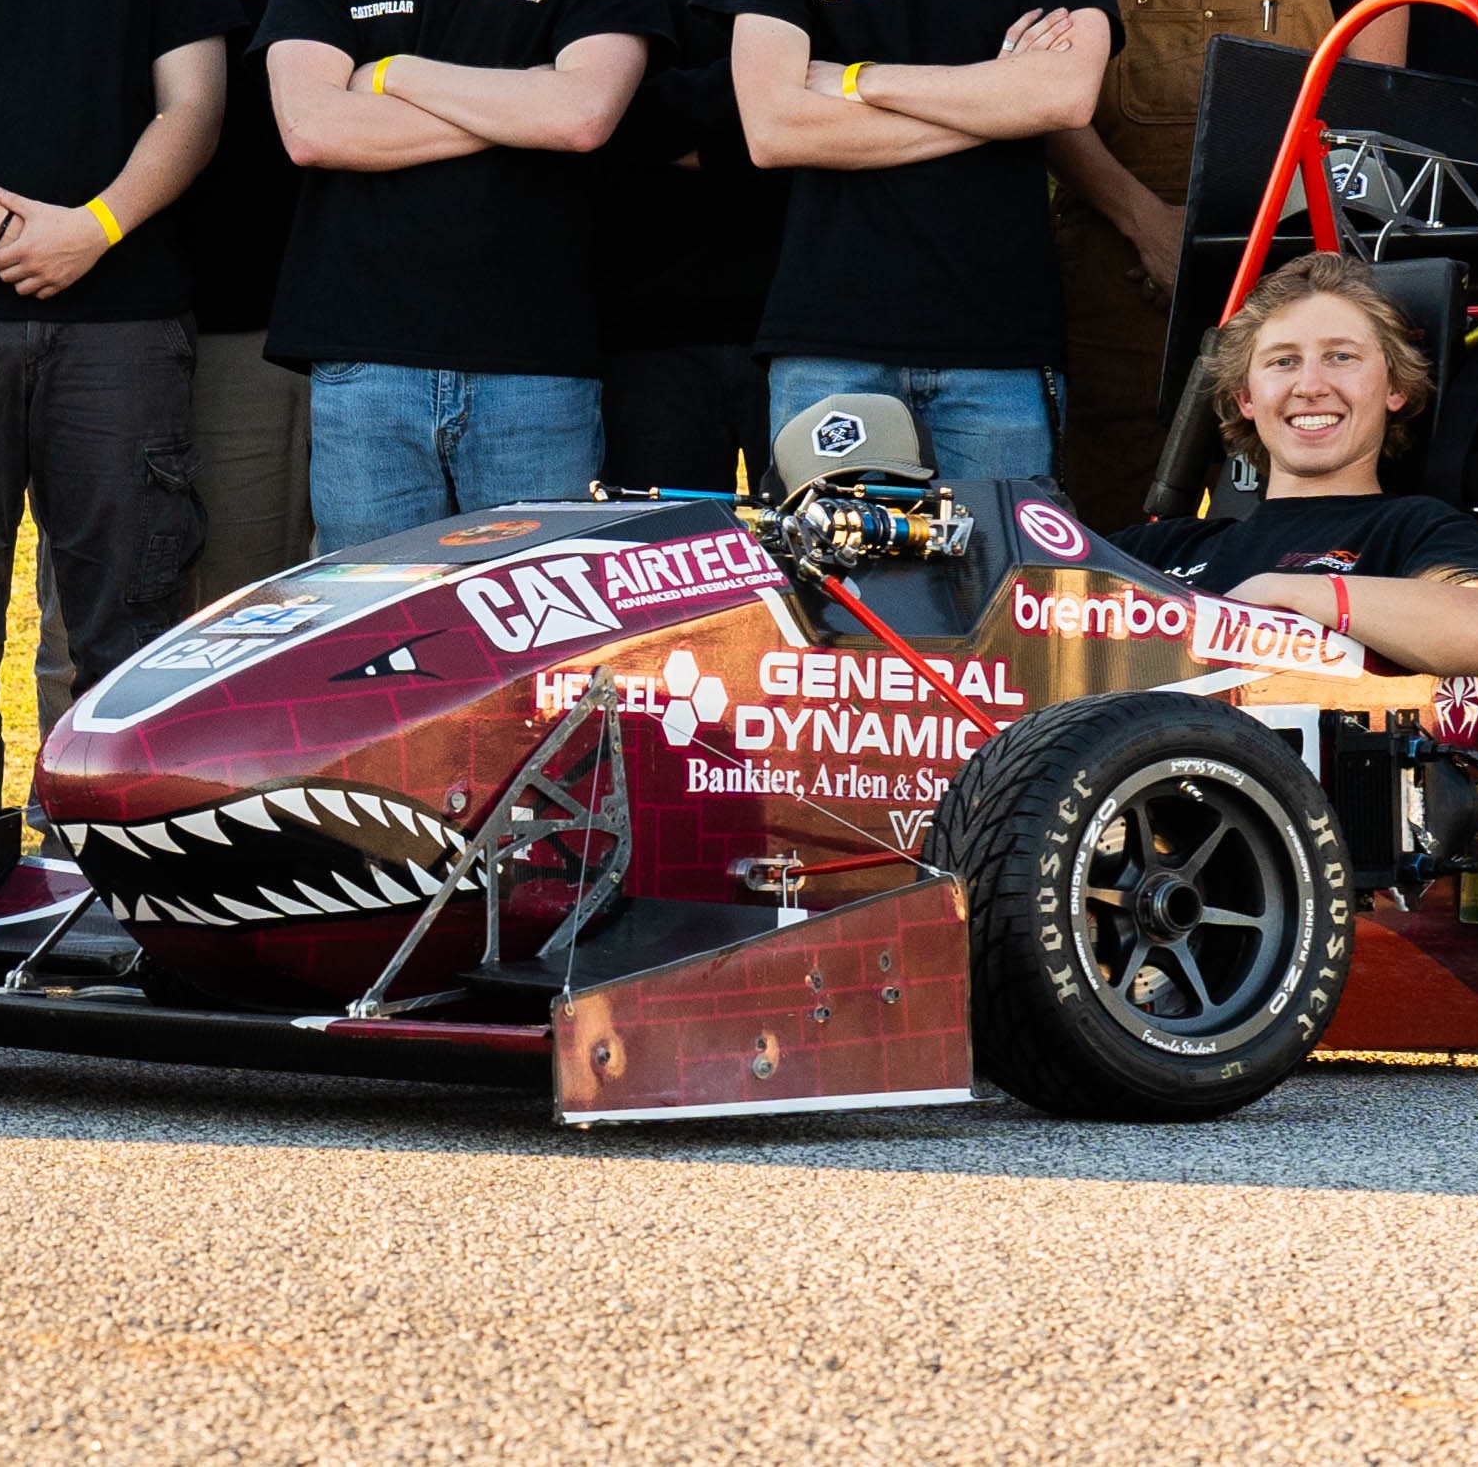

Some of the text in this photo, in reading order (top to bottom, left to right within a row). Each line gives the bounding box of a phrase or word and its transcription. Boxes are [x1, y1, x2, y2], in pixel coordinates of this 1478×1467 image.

[350, 0, 415, 20] CATERPILLAR
[604, 531, 781, 599] AIRTECH
[456, 556, 624, 653] CAT
[615, 571, 785, 611] ADVANCED MATERIALS GROUP
[1015, 582, 1189, 640] brembo
[139, 638, 277, 669] CAT
[1210, 606, 1348, 665] MoTeC
[536, 672, 666, 714] HECEL
[759, 651, 1025, 706] GENERAL
[735, 705, 1018, 761] DYNAMIC
[687, 759, 814, 801] Bankier,
[810, 765, 888, 801] Arlen
[893, 777, 913, 803] &
[1141, 1029, 1217, 1055] Formula Student
